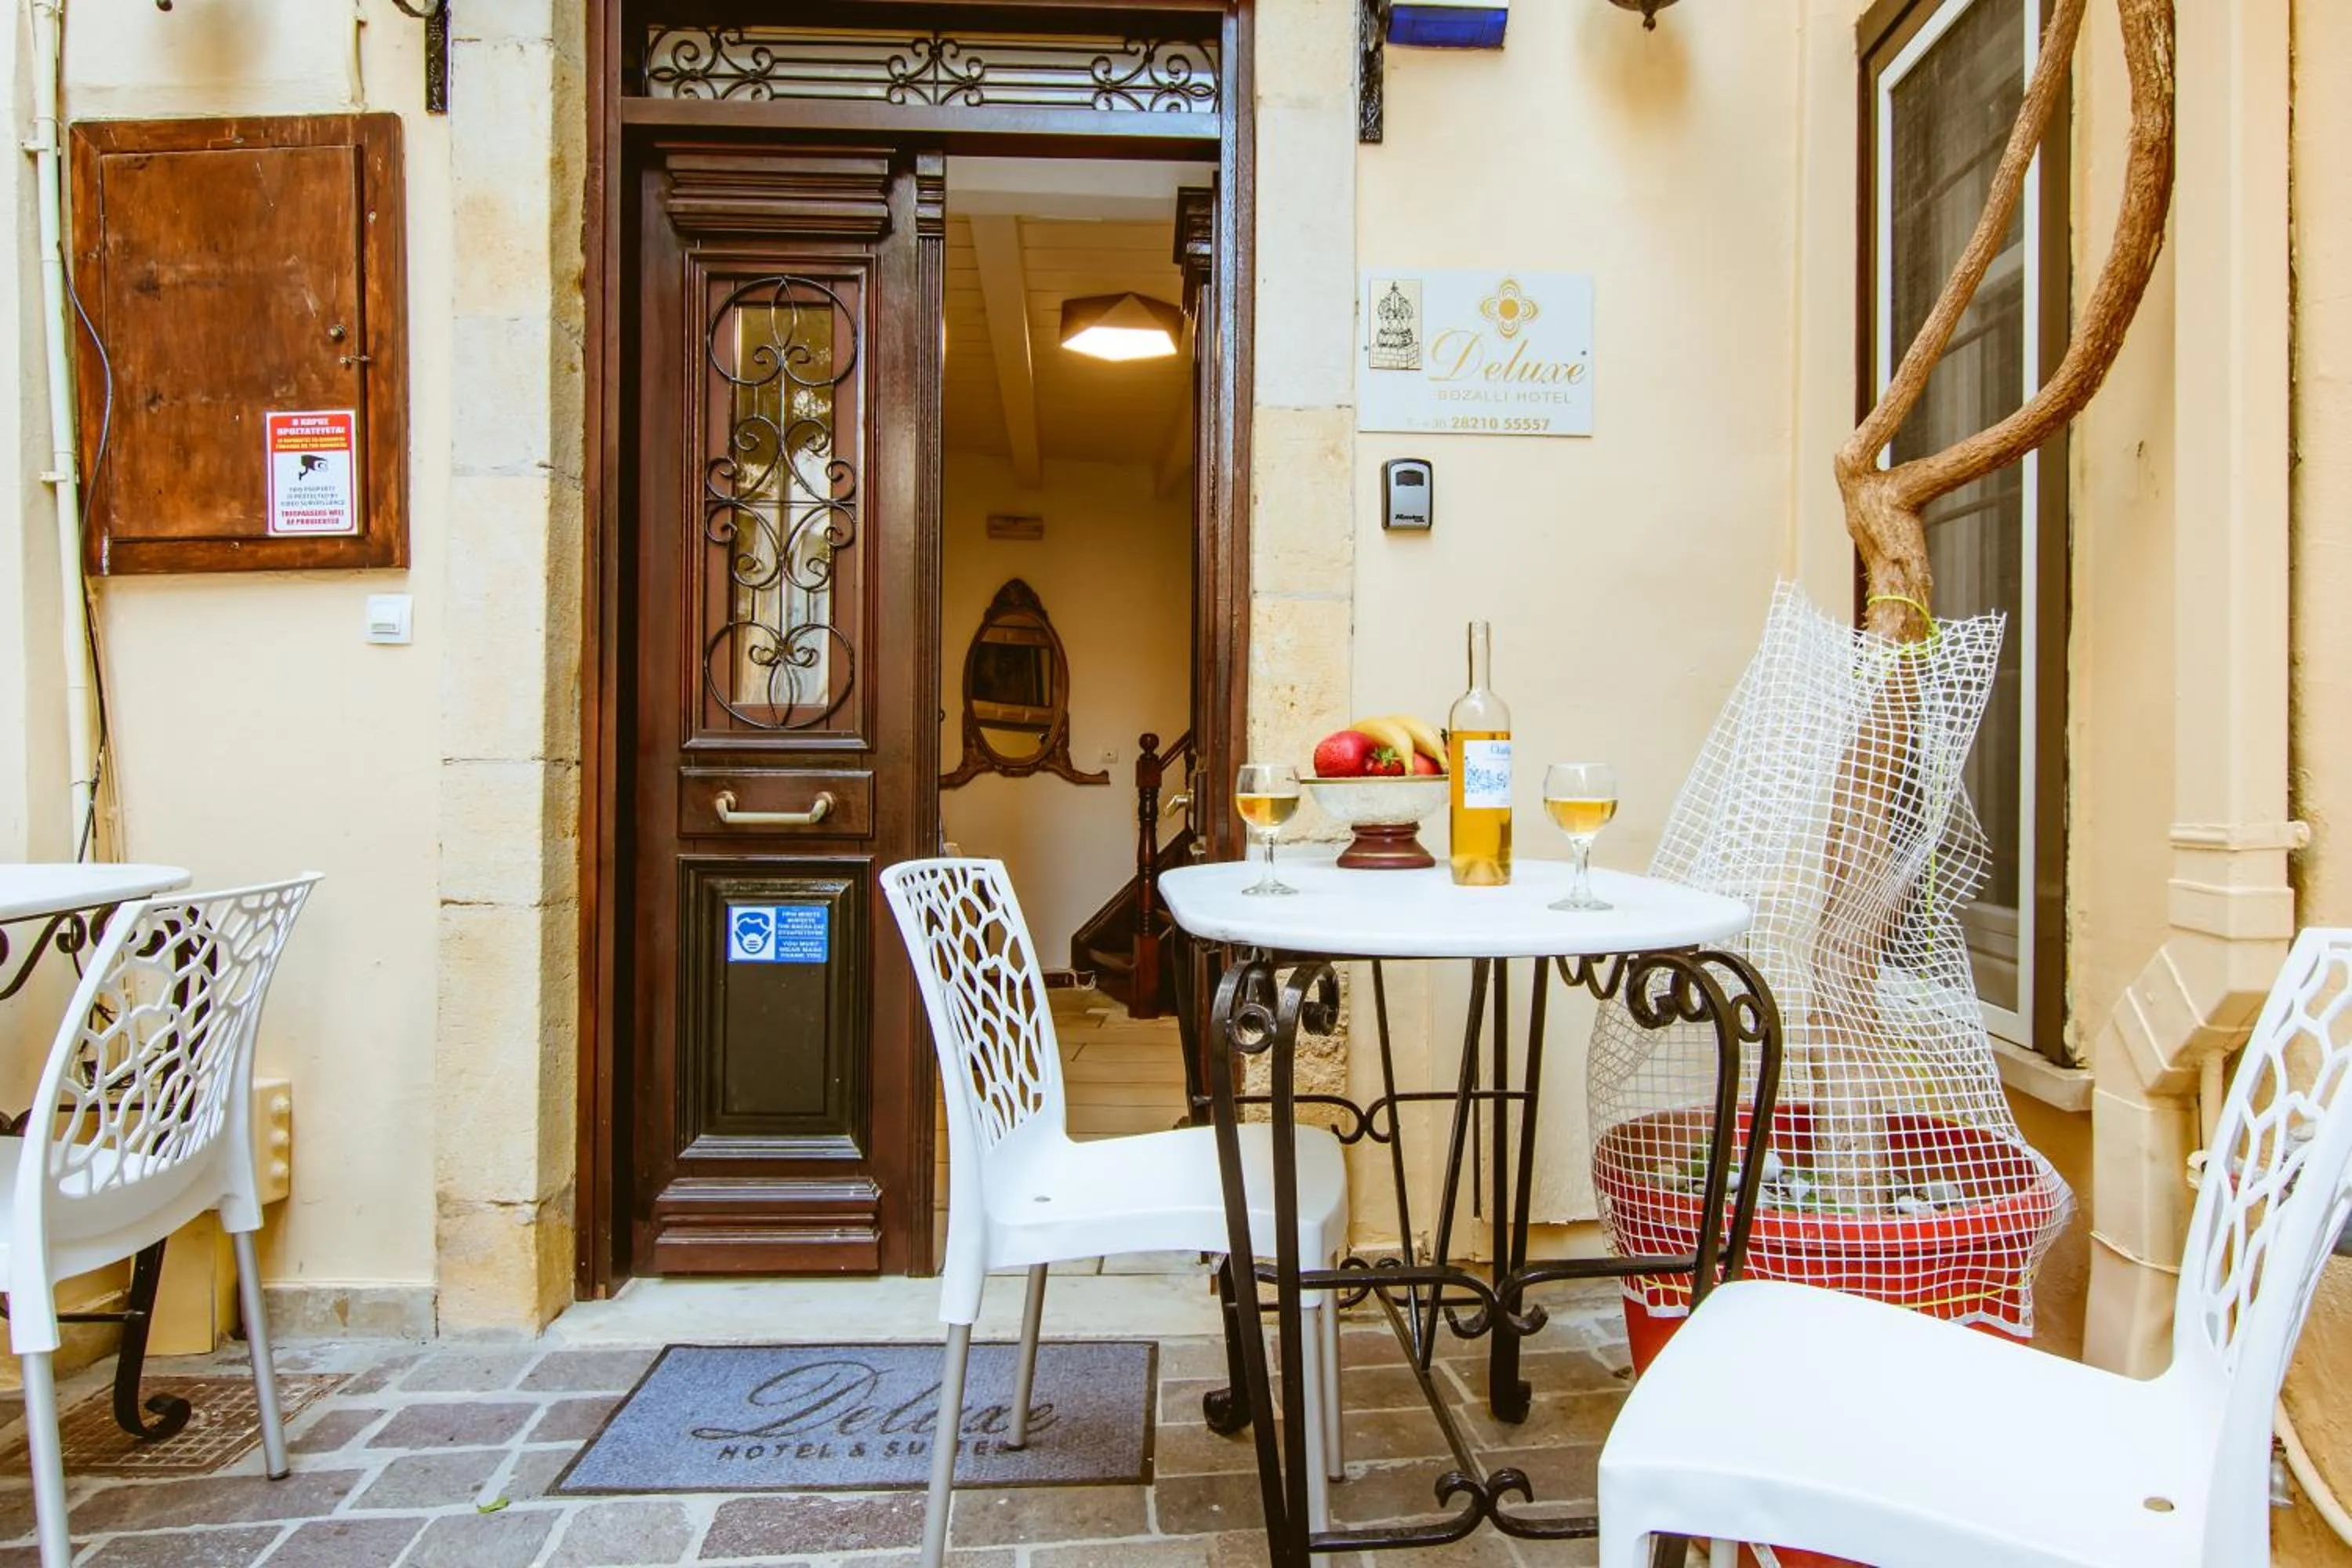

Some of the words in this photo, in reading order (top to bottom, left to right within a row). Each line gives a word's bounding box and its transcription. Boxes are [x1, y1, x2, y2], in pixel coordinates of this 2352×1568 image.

[1426, 328, 1585, 385] Deluxe
[1436, 390, 1509, 403] BOZALLI
[1517, 390, 1573, 405] HOTEL
[1450, 416, 1498, 430] 28210
[1504, 418, 1551, 430] 55557
[717, 1443, 833, 1461] HOTEL
[848, 1442, 866, 1457] &
